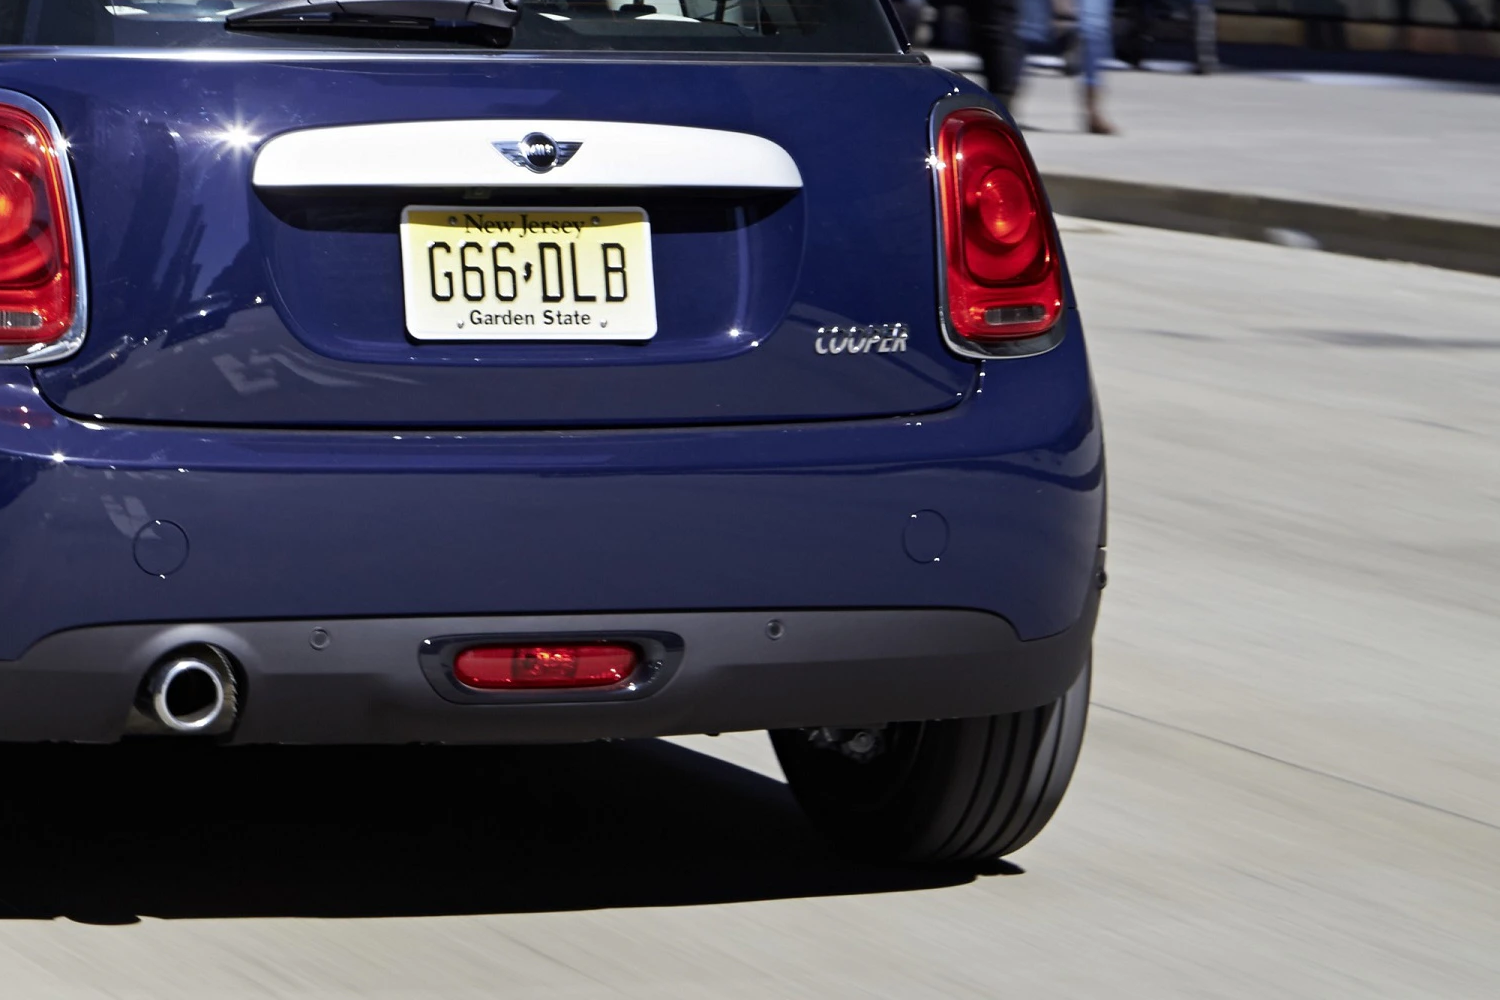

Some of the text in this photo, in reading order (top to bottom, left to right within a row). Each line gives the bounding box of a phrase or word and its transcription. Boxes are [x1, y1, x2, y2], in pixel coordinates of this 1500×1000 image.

[464, 213, 585, 238] New Jersey
[469, 309, 591, 325] Garden State
[814, 323, 908, 354] COOPER
